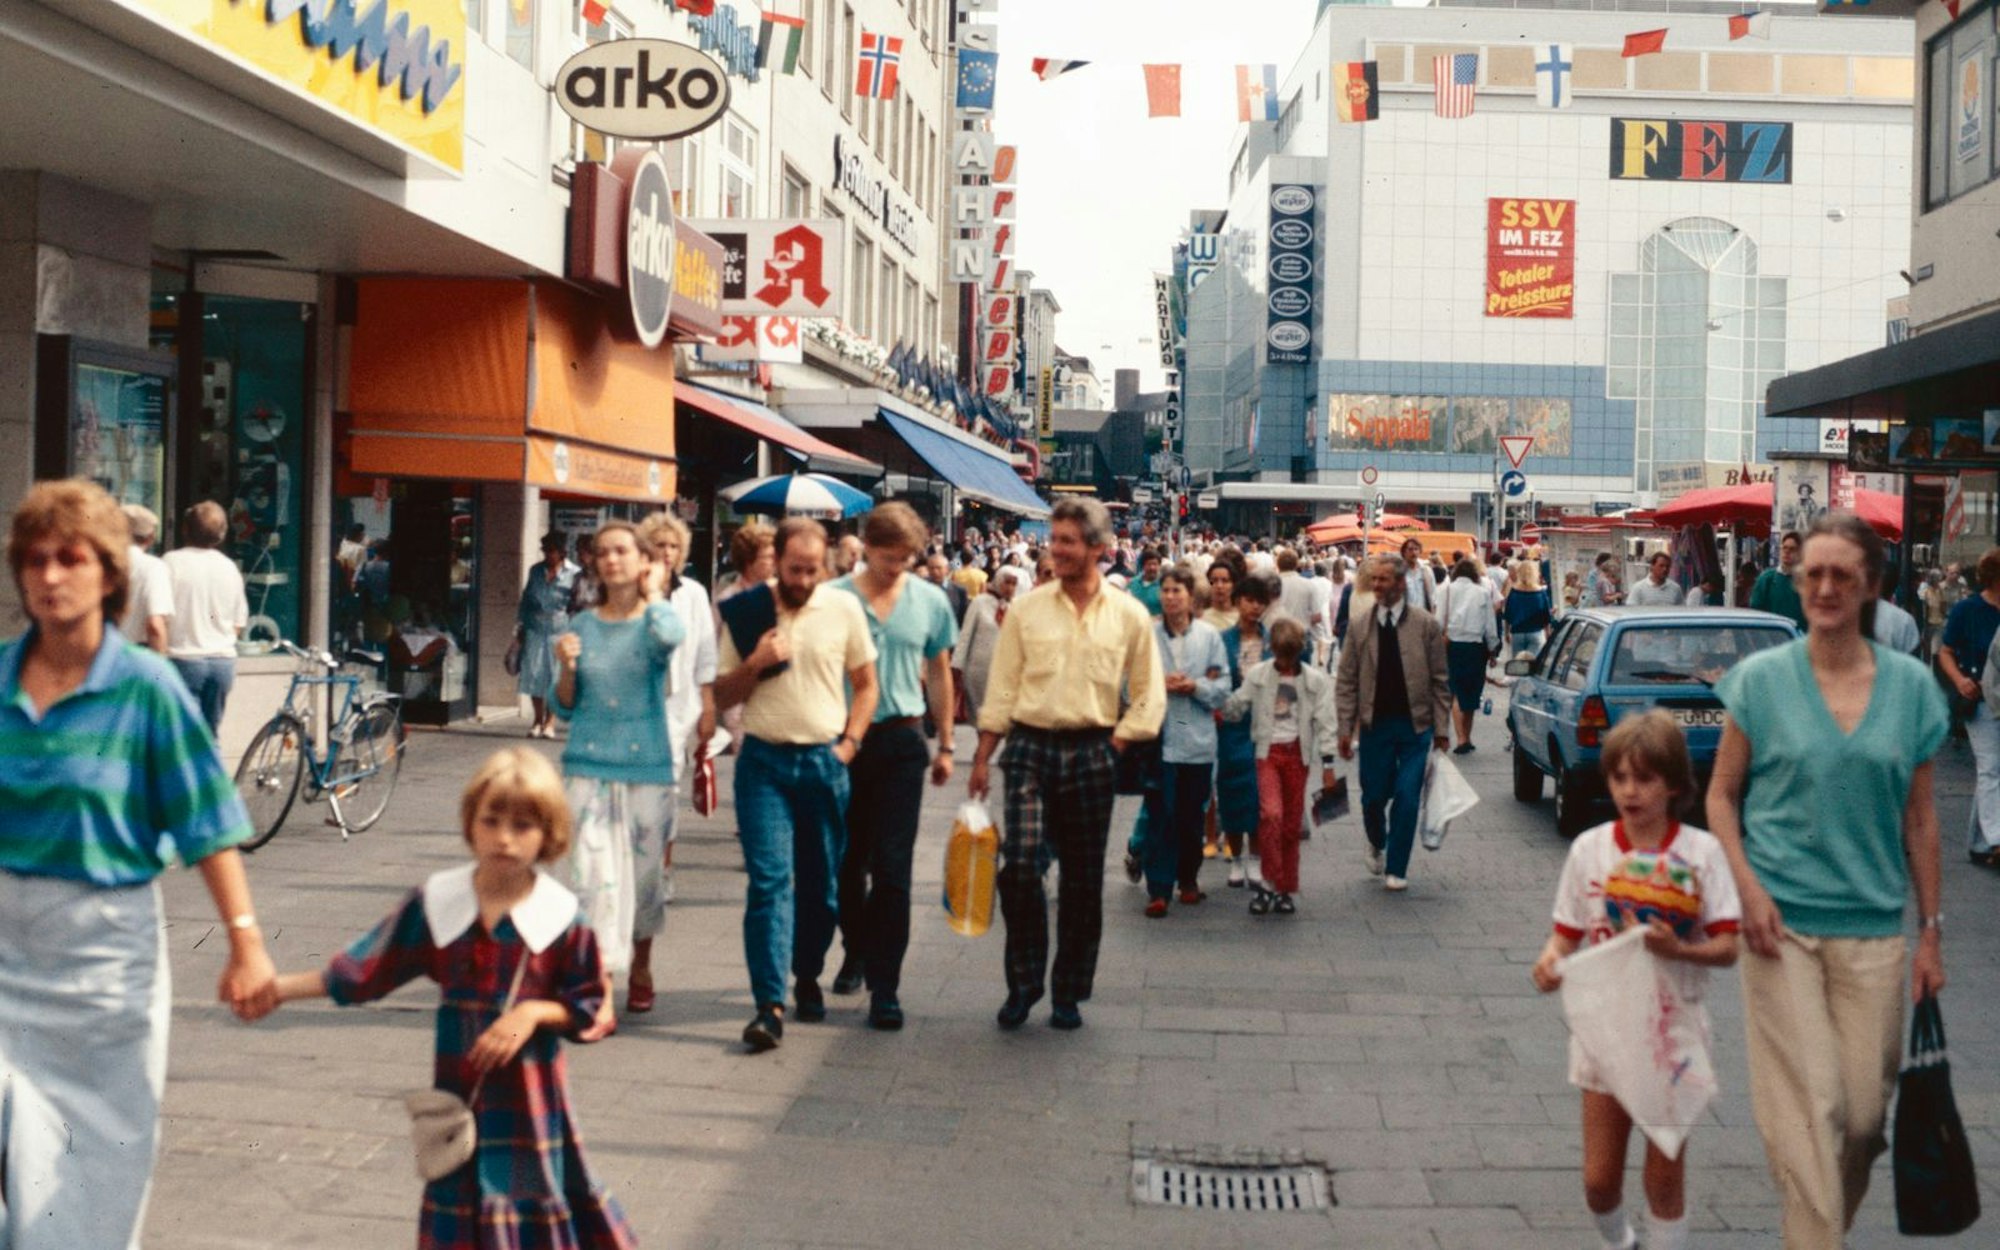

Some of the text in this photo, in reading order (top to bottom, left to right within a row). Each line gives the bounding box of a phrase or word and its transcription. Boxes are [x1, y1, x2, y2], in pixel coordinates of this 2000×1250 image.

[565, 49, 719, 110] arko
[1618, 119, 1786, 182] FEZ
[1501, 200, 1567, 228] SSV
[632, 193, 672, 283] arko
[1499, 229, 1564, 247] IM FEZ
[1498, 263, 1555, 289] Totaler
[1488, 283, 1573, 314] Preissturz
[1346, 406, 1432, 448] Seppälä
